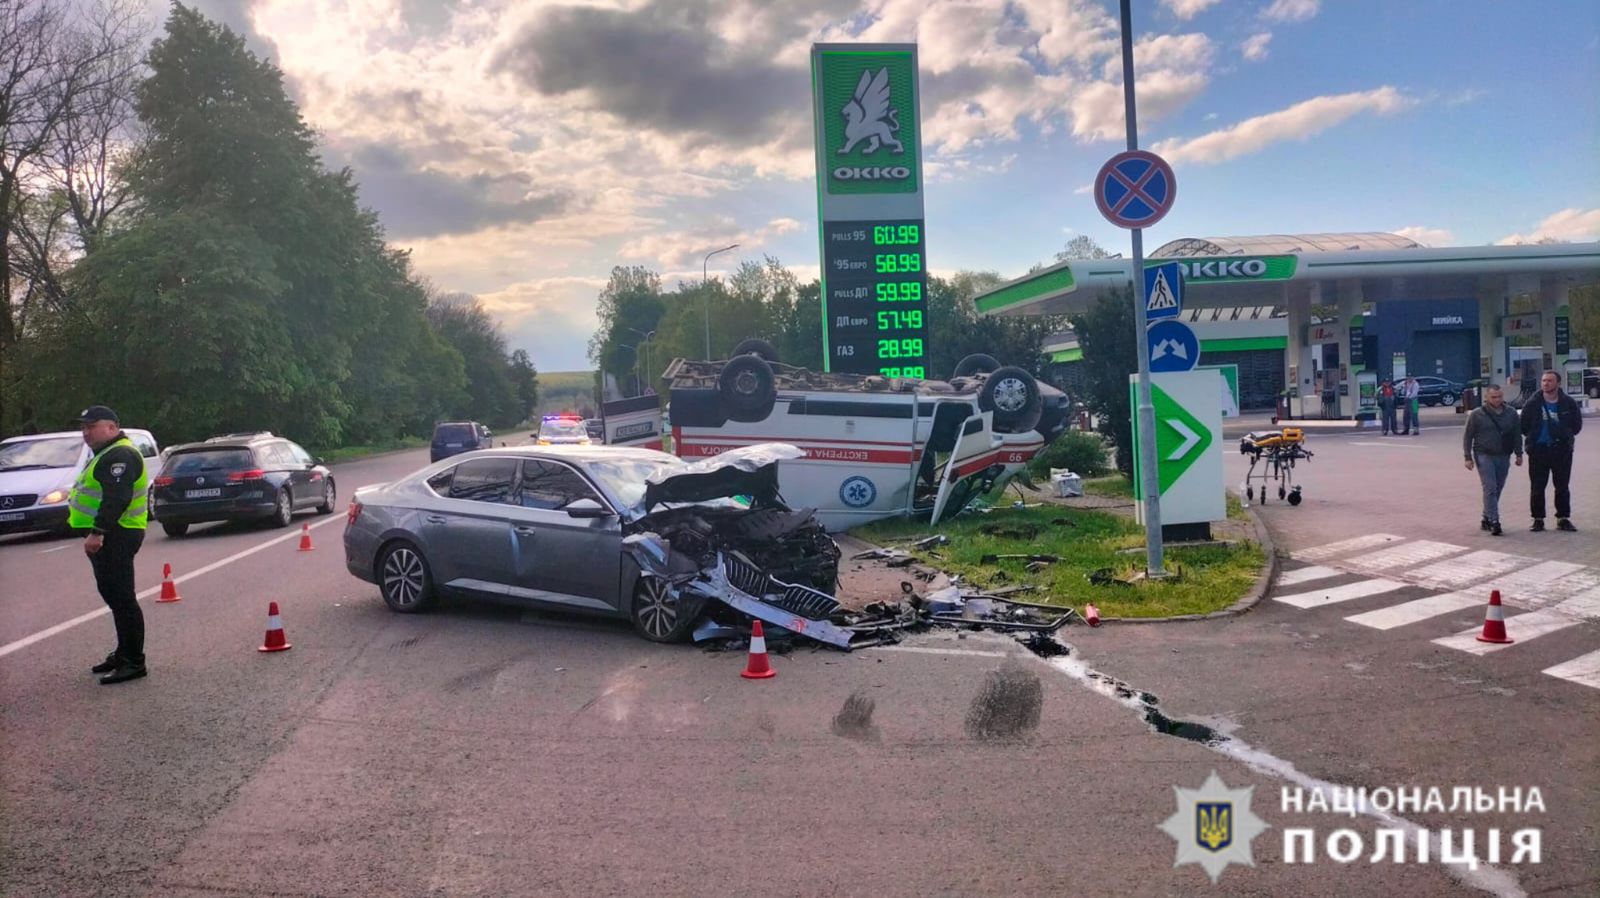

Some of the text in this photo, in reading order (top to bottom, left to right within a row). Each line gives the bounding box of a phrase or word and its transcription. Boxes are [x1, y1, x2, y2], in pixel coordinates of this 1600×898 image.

[833, 166, 911, 179] OKKO
[852, 230, 866, 241] 95
[874, 225, 919, 245] 60.99
[876, 253, 921, 273] 58.99
[855, 287, 868, 299] ДП
[876, 282, 921, 302] 59.99
[836, 315, 849, 328] ДП
[878, 310, 923, 330] 57.49
[837, 338, 923, 358] ГАЗ 28.99
[815, 448, 868, 461] ЕКСТРЕНА
